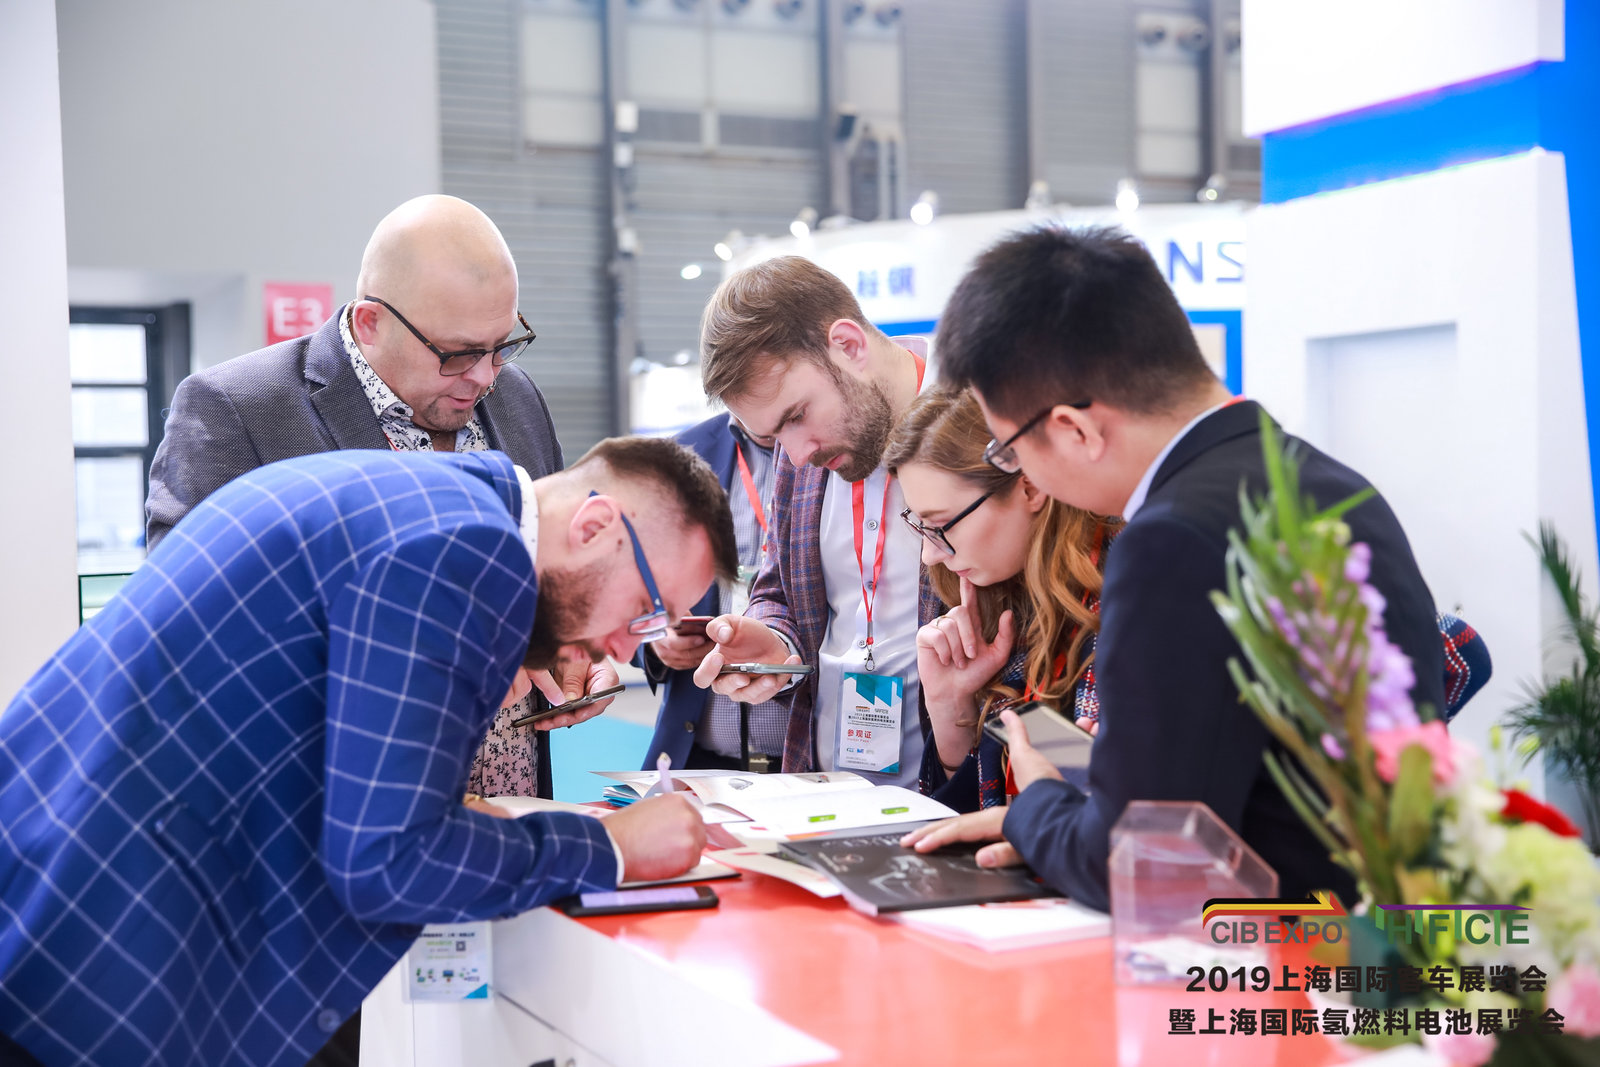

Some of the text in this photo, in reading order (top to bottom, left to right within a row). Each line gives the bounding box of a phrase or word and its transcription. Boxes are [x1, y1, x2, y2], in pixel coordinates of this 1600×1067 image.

[273, 297, 324, 336] E3
[847, 729, 872, 739] 参观证
